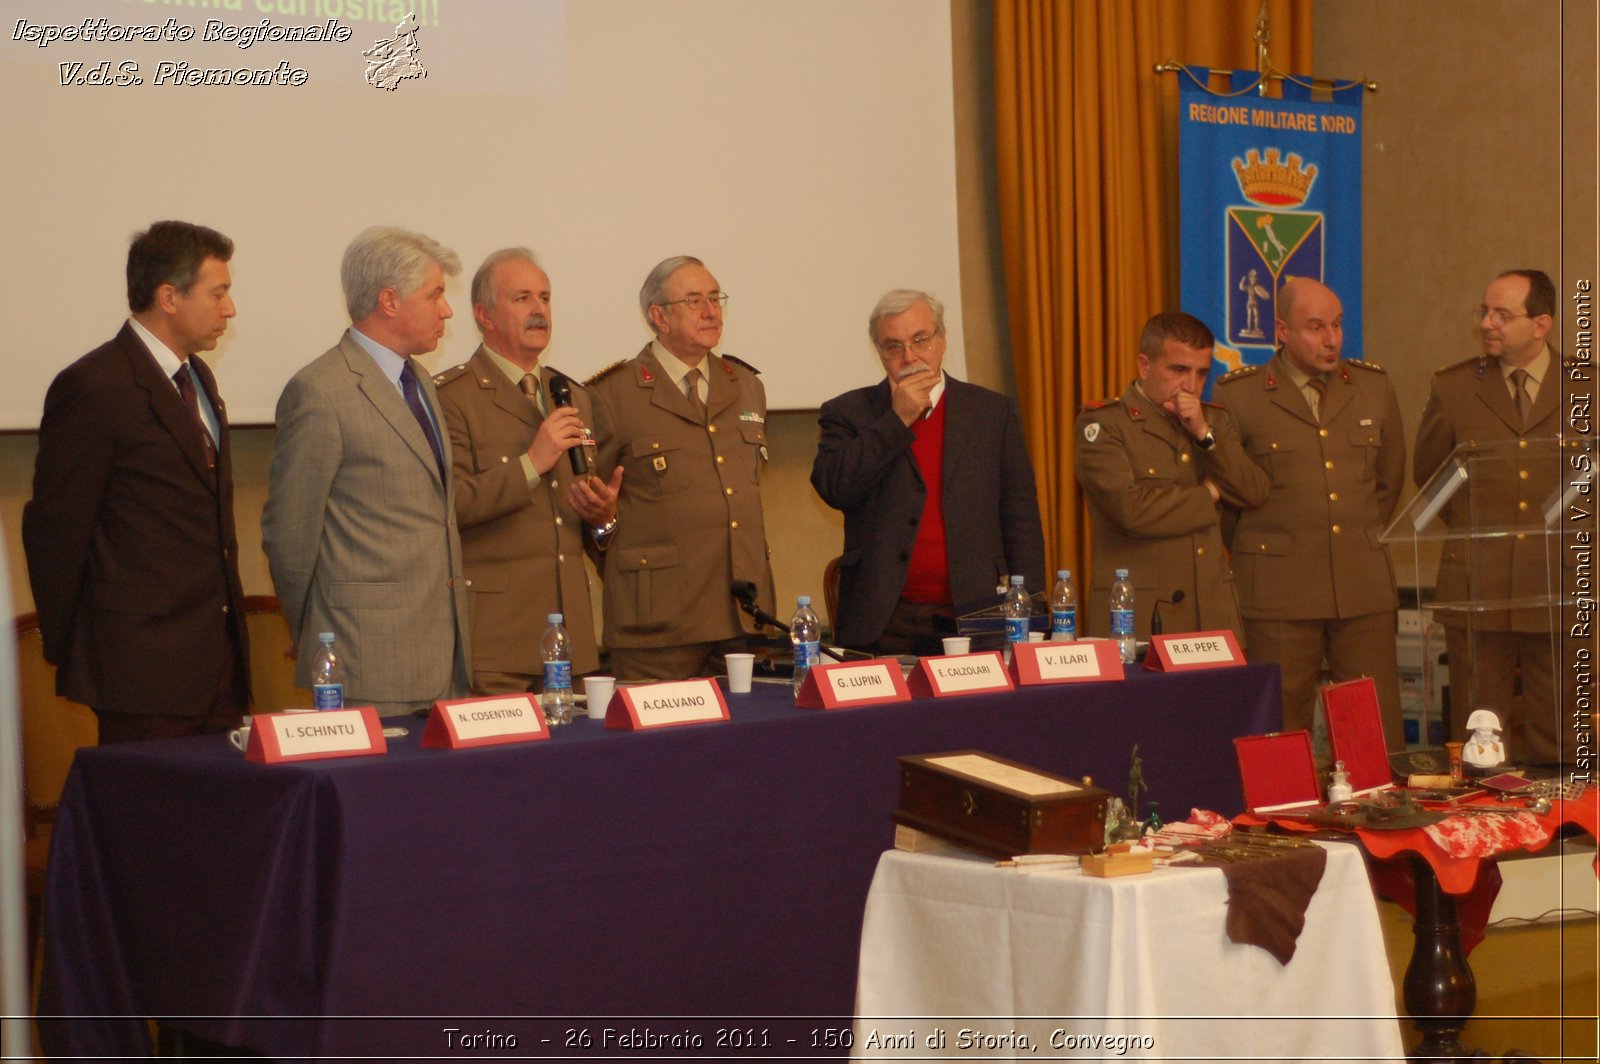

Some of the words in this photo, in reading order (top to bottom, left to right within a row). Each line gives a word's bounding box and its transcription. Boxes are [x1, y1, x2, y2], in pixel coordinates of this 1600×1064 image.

[1189, 103, 1249, 125] REGIONE
[1252, 108, 1317, 132] MILITARE
[1320, 114, 1356, 135] NORD
[1172, 643, 1194, 654] R.R.
[1196, 641, 1219, 653] PEPE
[1045, 656, 1057, 665] V.
[1059, 654, 1088, 665] ILARI
[939, 669, 947, 678] E.
[947, 665, 991, 677] CALZOLARI
[837, 678, 849, 688] G.
[850, 675, 882, 687] LUPINI
[643, 695, 706, 711] A.CALVANO
[458, 713, 471, 723] N.
[471, 708, 524, 722] COSENTINO
[285, 727, 295, 739] I.
[297, 724, 355, 738] SCHINTU
